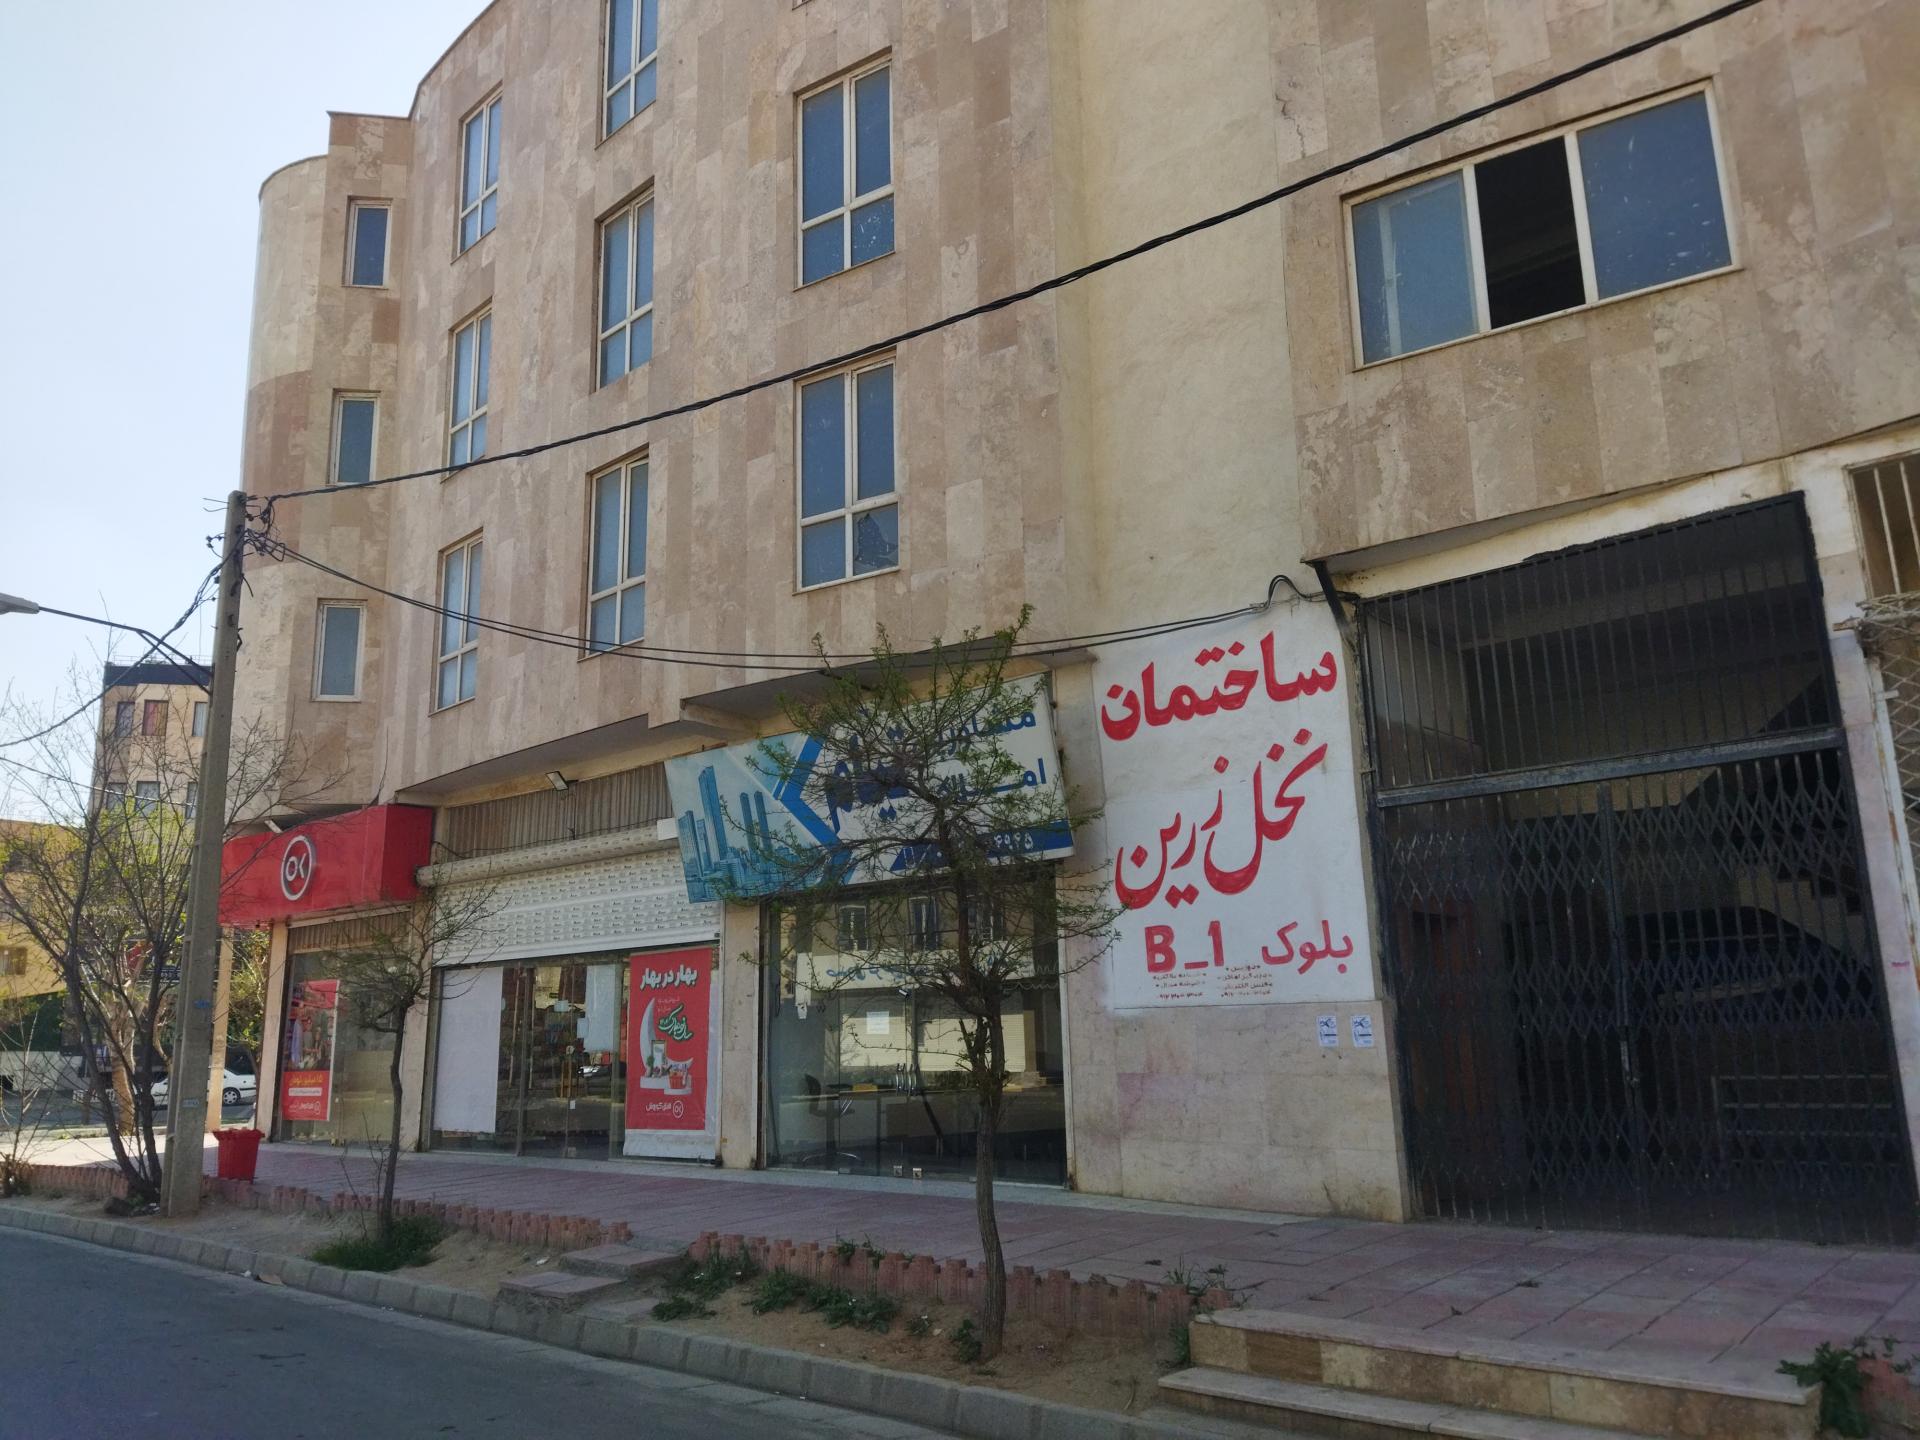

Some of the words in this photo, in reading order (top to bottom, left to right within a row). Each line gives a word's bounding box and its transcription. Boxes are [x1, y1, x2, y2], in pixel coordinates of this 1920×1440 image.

[1101, 631, 1338, 741] ساختمان
[1114, 755, 1229, 910] زرین
[1204, 728, 1328, 896] نخل
[674, 964, 698, 986] بهار
[1261, 919, 1354, 976] بلوک
[640, 967, 662, 990] بهار
[662, 969, 674, 988] در
